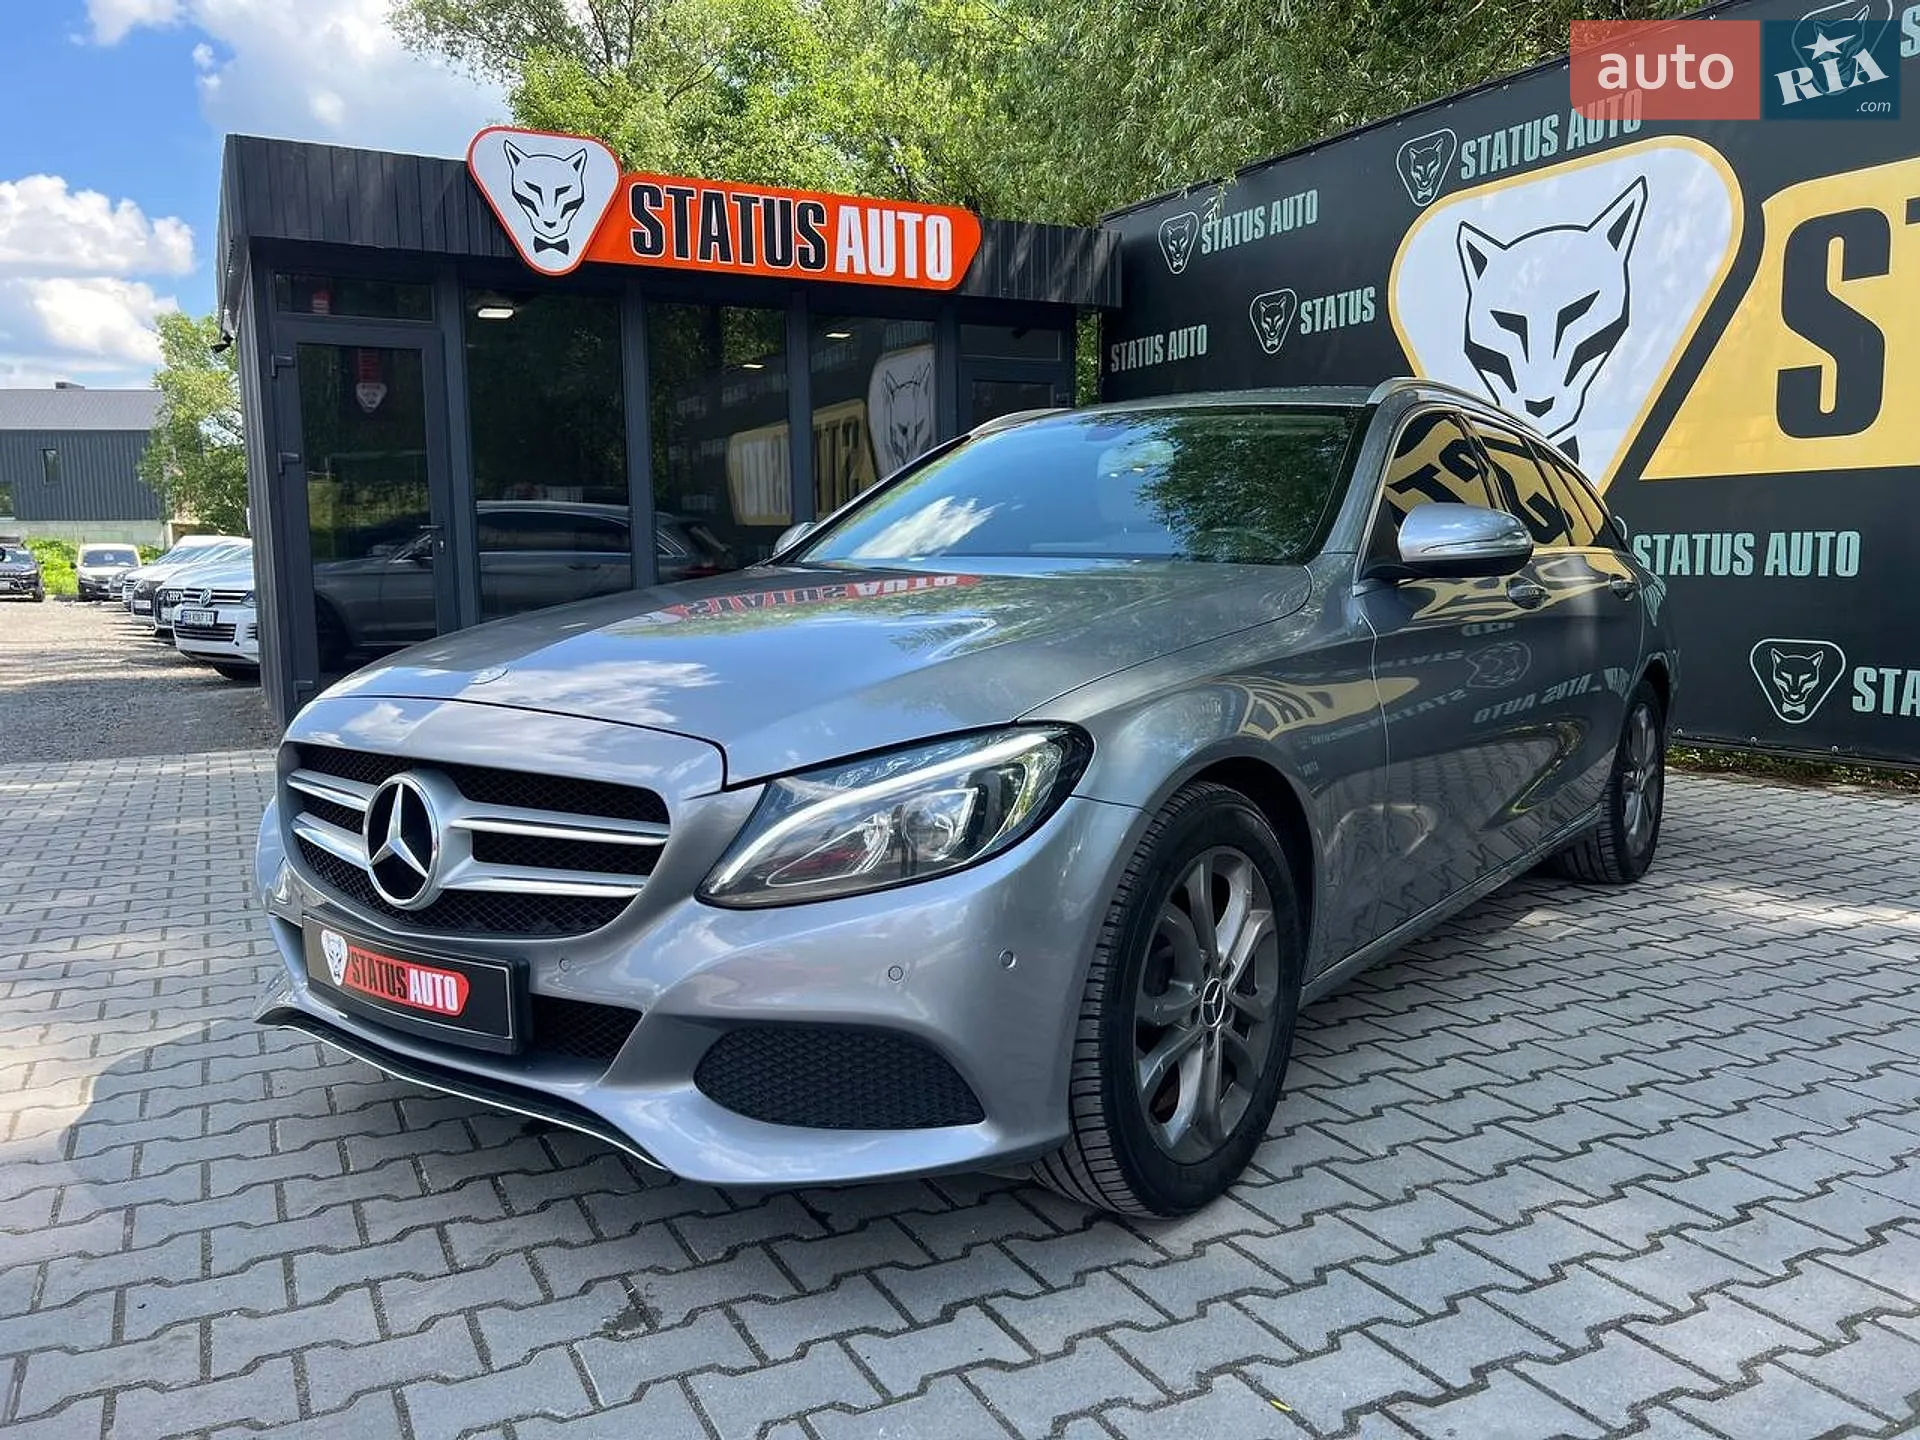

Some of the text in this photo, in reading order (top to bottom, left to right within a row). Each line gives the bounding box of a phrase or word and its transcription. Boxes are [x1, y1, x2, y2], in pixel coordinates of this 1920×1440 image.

[1460, 89, 1644, 181] STATUS AUTO
[629, 183, 953, 283] STATUS AUTO
[1201, 189, 1319, 254] STATUS AUTO
[1300, 286, 1376, 335] STATUS
[1776, 197, 1920, 439] S
[1111, 324, 1208, 373] STATUS AUTO
[1764, 530, 1862, 578] AUTO
[351, 951, 459, 1012] STATUS AUTO
